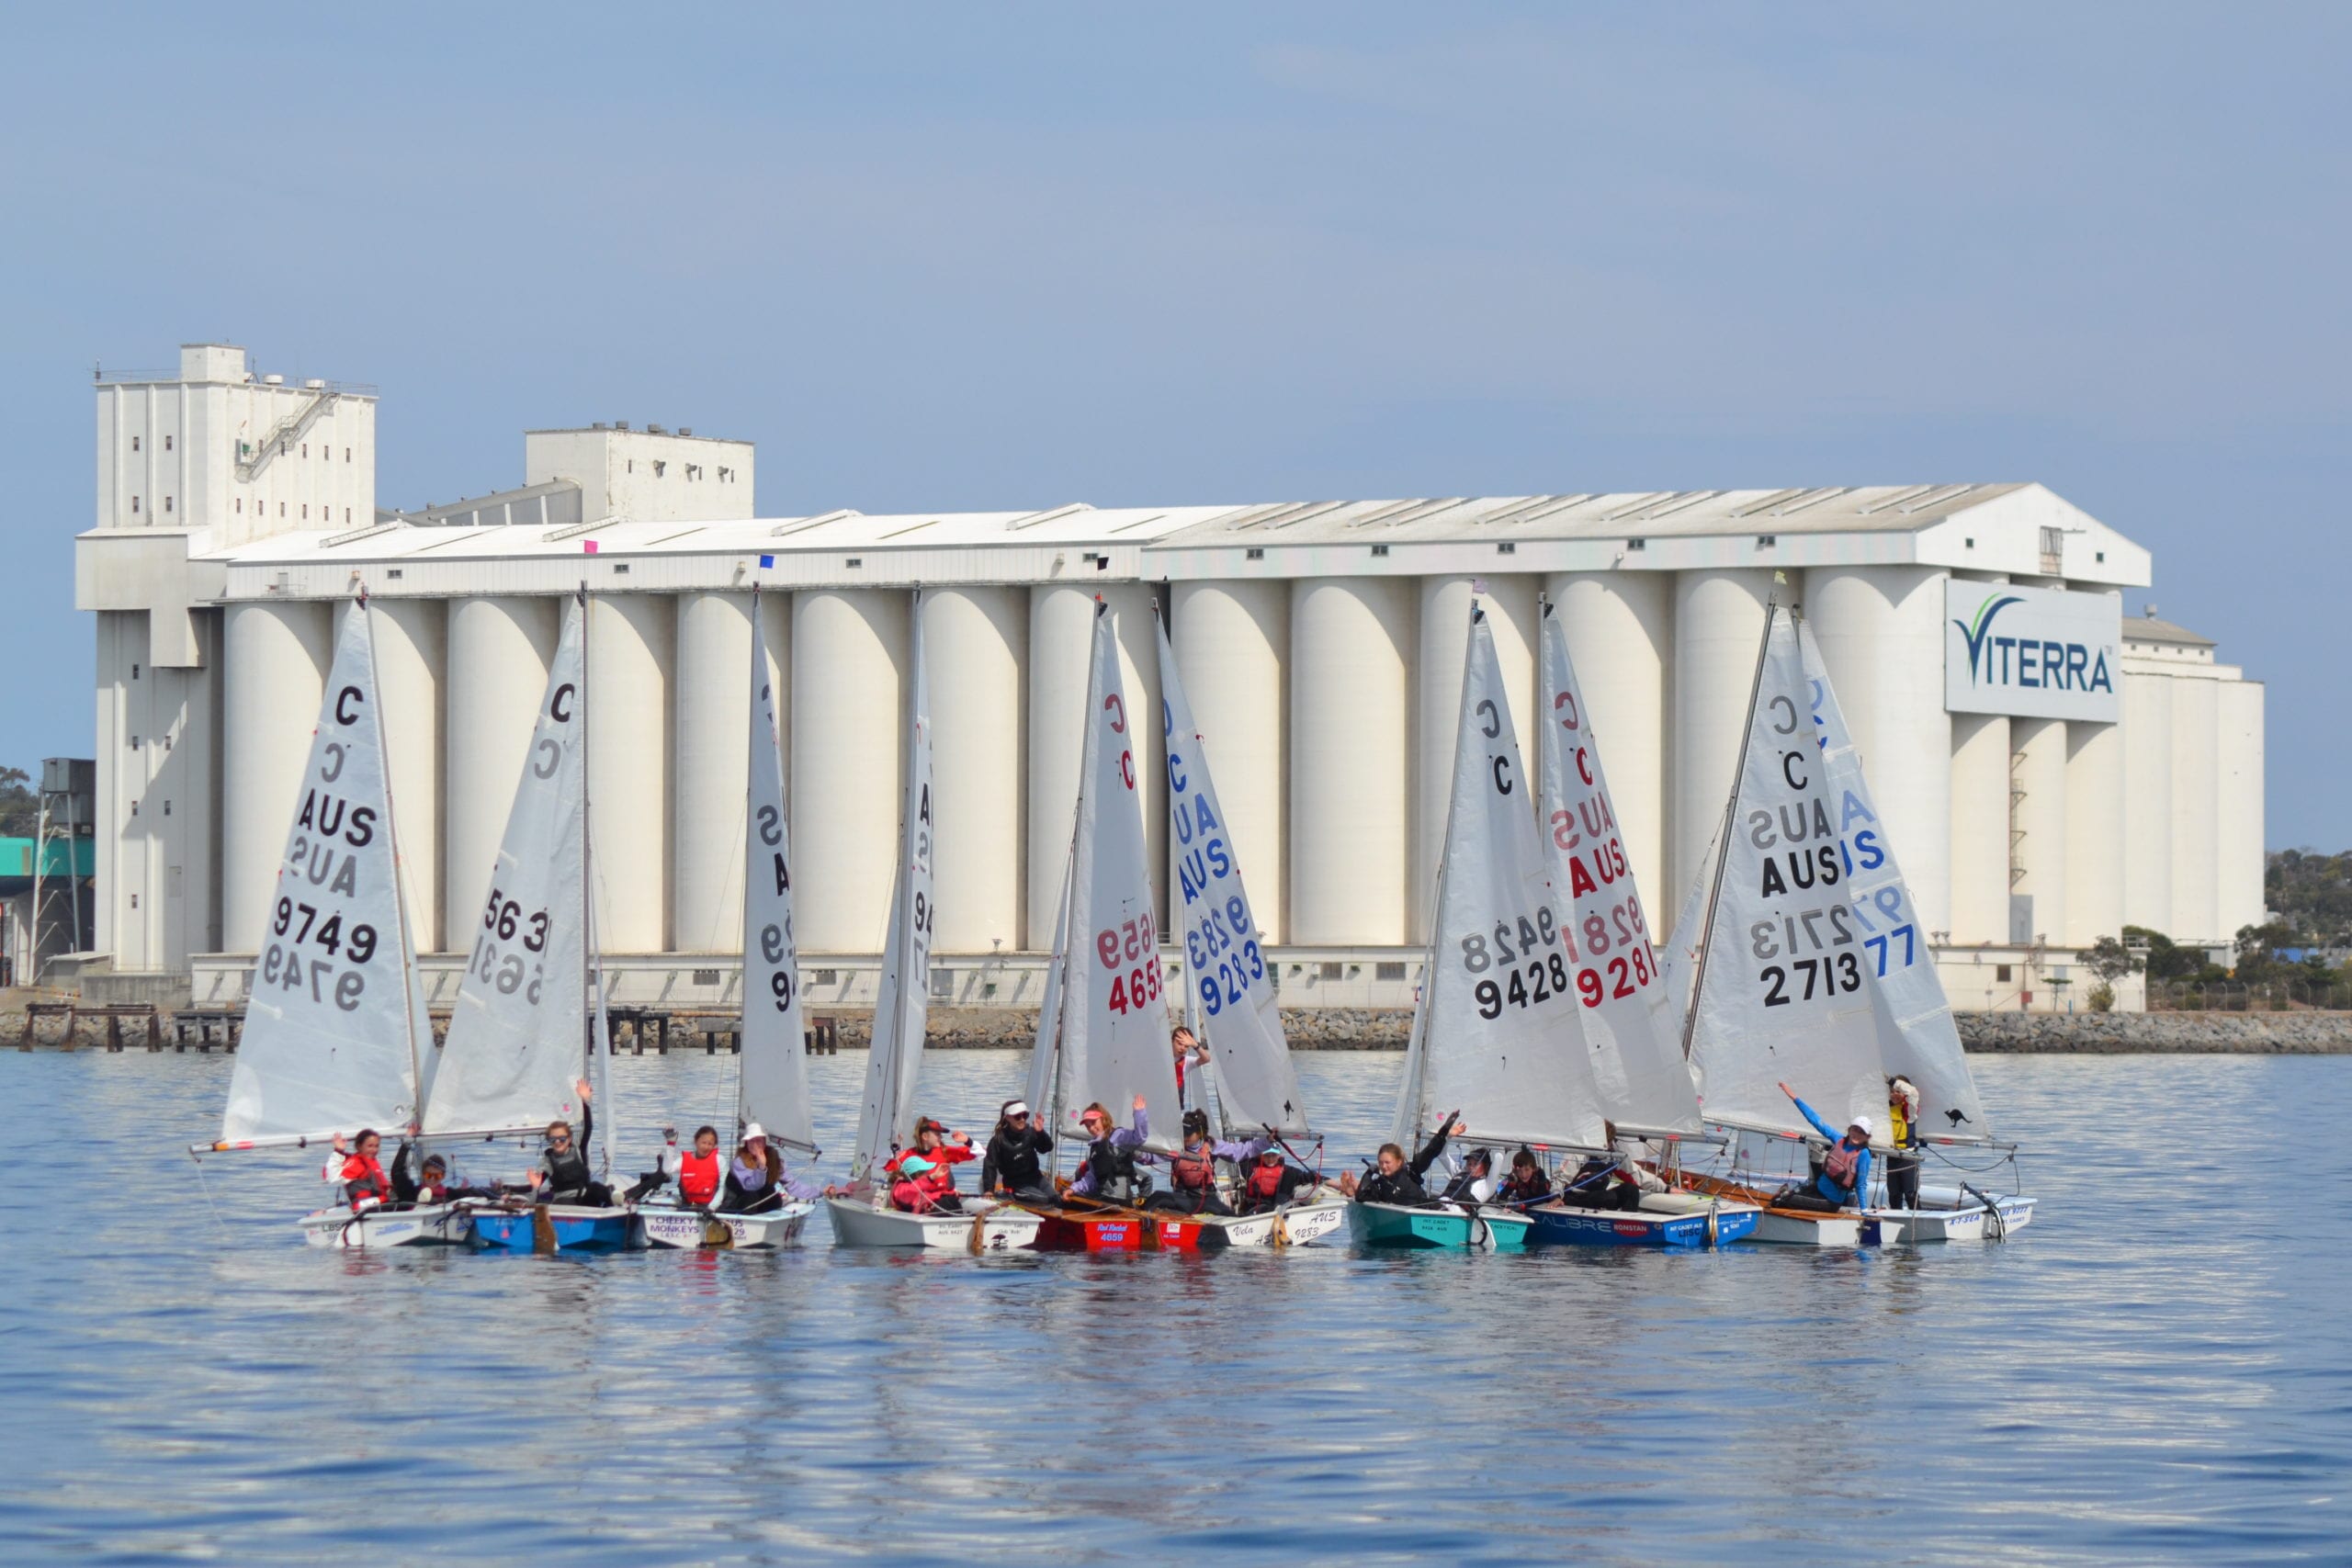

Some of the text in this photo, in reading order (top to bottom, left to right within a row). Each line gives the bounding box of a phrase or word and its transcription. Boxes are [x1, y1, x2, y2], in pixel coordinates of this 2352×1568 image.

[1951, 592, 2113, 694] VITERRA
[336, 686, 364, 726] C
[551, 683, 574, 723] C
[1121, 750, 1134, 790] C
[1169, 753, 1187, 792] C
[1494, 755, 1513, 795] C
[1577, 746, 1592, 786] C
[1783, 750, 1808, 791] C
[299, 788, 377, 847] AUS
[1179, 840, 1229, 905] AUS
[1569, 838, 1625, 900] AUS
[1761, 845, 1839, 898] AUS
[274, 896, 378, 964] 9749
[1863, 923, 1915, 977] 77
[1108, 956, 1163, 1016] 4659
[1200, 940, 1263, 1017] 9283
[1475, 953, 1567, 1020] 9428
[1576, 939, 1657, 1009] 9281
[1760, 952, 1860, 1008] 2713
[650, 1224, 699, 1234] MONKEYS
[655, 1215, 693, 1225] CHEEKY
[1295, 1226, 1320, 1239] 9283
